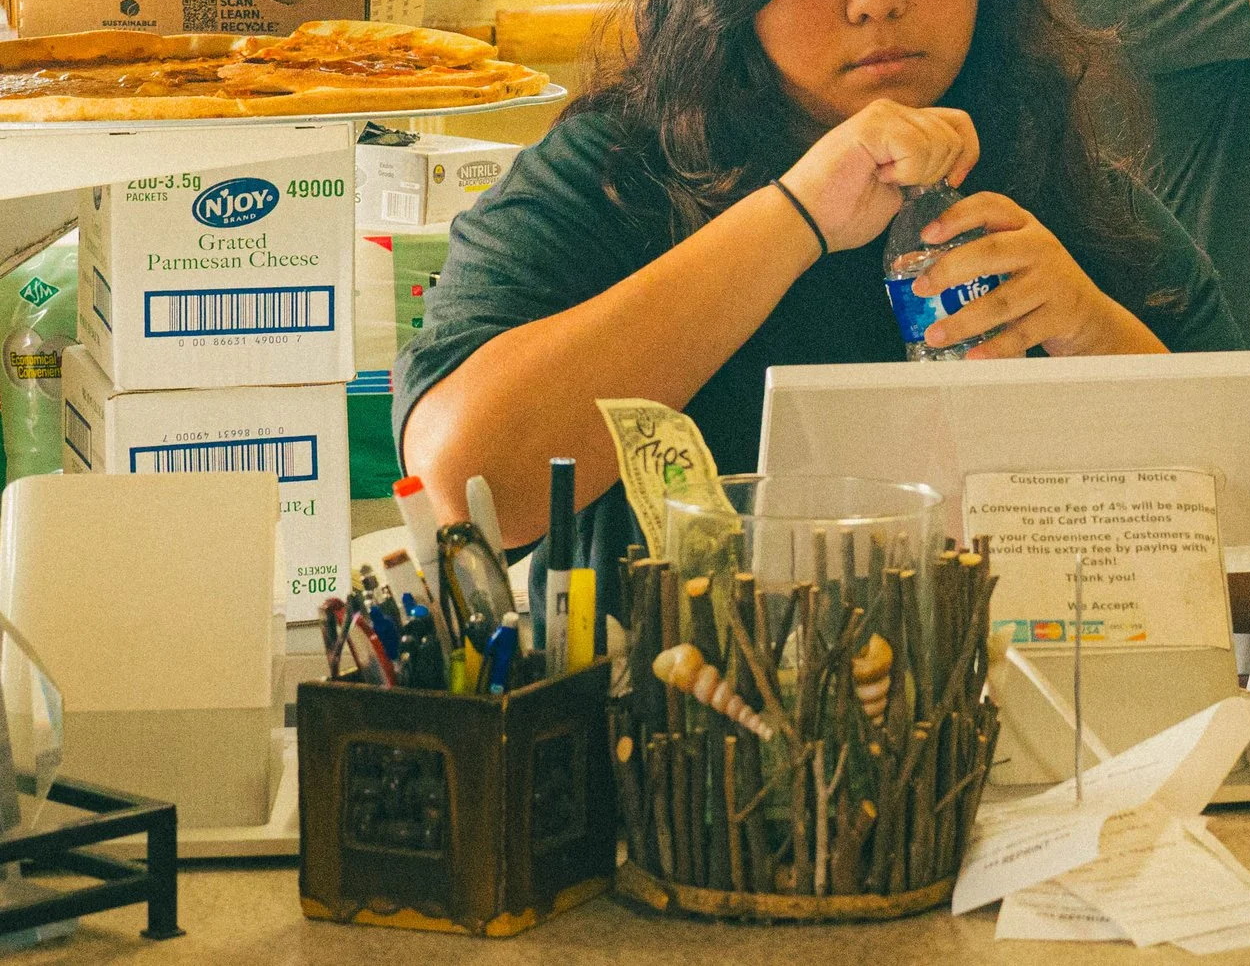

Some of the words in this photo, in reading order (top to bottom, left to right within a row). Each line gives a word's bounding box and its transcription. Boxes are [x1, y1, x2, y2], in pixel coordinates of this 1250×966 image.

[220, 10, 264, 20] LEARN.
[460, 163, 499, 179] NITRILE
[286, 179, 344, 198] 49000
[126, 192, 168, 202] PACKETS
[223, 213, 257, 224] BRAND
[198, 233, 267, 250] Grated
[147, 252, 241, 271] Parmesan
[249, 251, 319, 268] Cheese
[958, 282, 990, 305] Life
[178, 339, 185, 347] 0
[192, 338, 206, 347] 00
[213, 336, 247, 346] 86631
[255, 335, 289, 344] 49000
[296, 334, 302, 343] 7
[10, 352, 57, 366] Economical
[17, 366, 62, 379] Convenien
[218, 429, 250, 440] 86631
[257, 427, 271, 436] 00
[278, 426, 284, 435] 0
[162, 434, 169, 443] 7
[175, 432, 209, 442] 49000
[1010, 474, 1070, 485] Customer
[1082, 473, 1126, 484] Pricing
[1137, 472, 1177, 482] Notice
[969, 505, 977, 514] A
[981, 503, 1061, 513] Convenience
[1065, 504, 1088, 513] Fee
[1091, 502, 1104, 512] of
[1108, 501, 1127, 511] 4%
[1131, 500, 1153, 510] will
[1157, 501, 1172, 510] be
[1022, 517, 1035, 525] to
[1039, 516, 1054, 525] all
[1058, 516, 1087, 525] Card
[1091, 514, 1172, 524] Transactions
[999, 535, 1027, 543] your
[1031, 533, 1111, 542] Convenience
[1124, 530, 1190, 540] Customers
[1027, 545, 1051, 554] this
[1054, 545, 1087, 554] extra
[1091, 544, 1112, 553] fee
[1116, 544, 1130, 554] by
[1135, 542, 1178, 554] paying
[1182, 543, 1207, 553] with
[1081, 556, 1117, 566] Cash!
[297, 564, 338, 576] PACKETS
[1108, 572, 1136, 584] you!
[287, 577, 337, 595] 200-3.
[1091, 601, 1139, 612] Accept:
